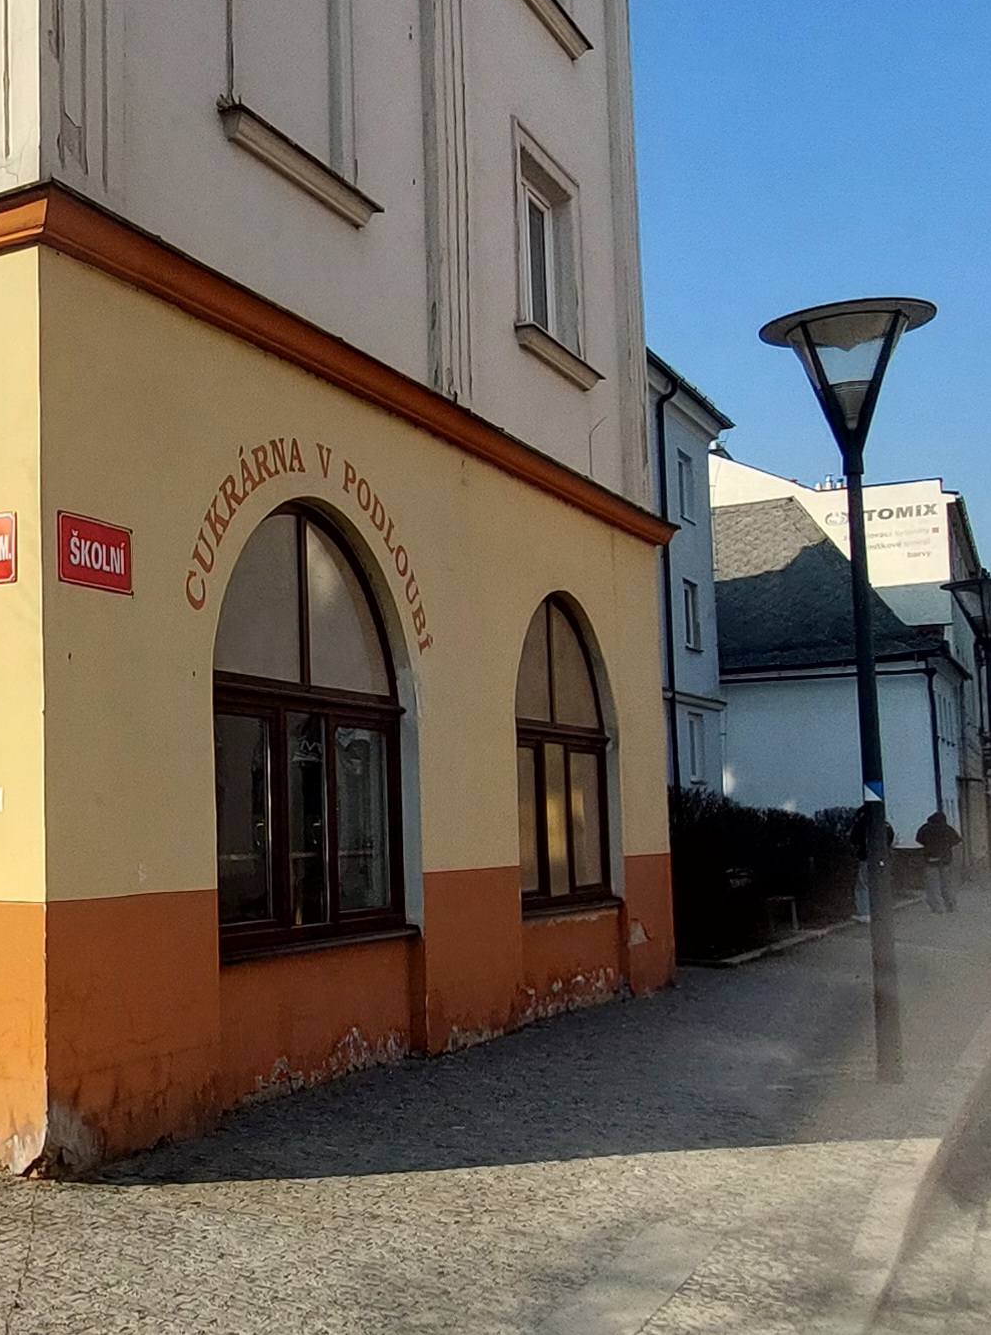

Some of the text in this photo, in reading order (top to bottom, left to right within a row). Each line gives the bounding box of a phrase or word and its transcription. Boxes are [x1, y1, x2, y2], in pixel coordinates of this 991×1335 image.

[863, 503, 938, 522] TOMIX
[69, 528, 125, 576] ŠKOLNÍ
[185, 437, 434, 656] CUKRÁRNA V PODLOUBÍ
